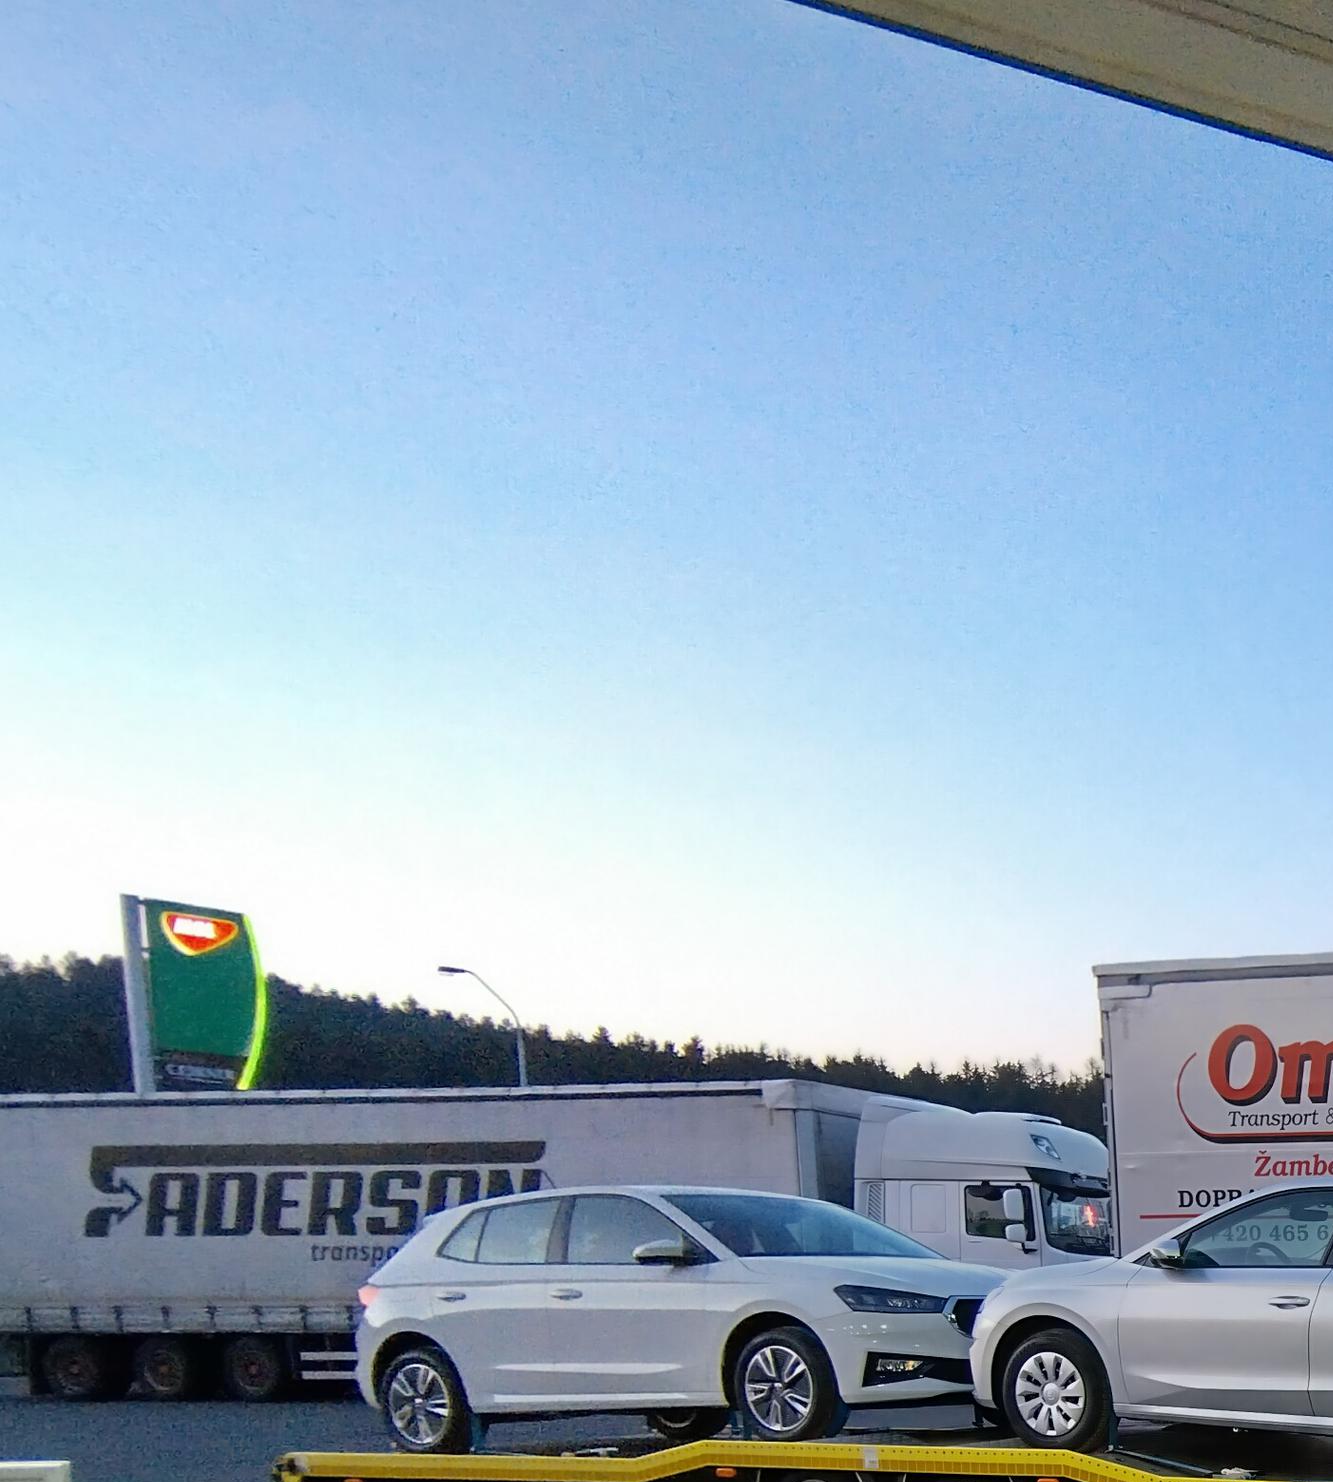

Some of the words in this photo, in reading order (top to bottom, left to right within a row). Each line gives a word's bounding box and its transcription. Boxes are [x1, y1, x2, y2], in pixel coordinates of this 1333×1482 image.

[1228, 1108, 1319, 1130] Transport
[1178, 1188, 1255, 1208] DOPR
[1269, 1223, 1309, 1241] 465
